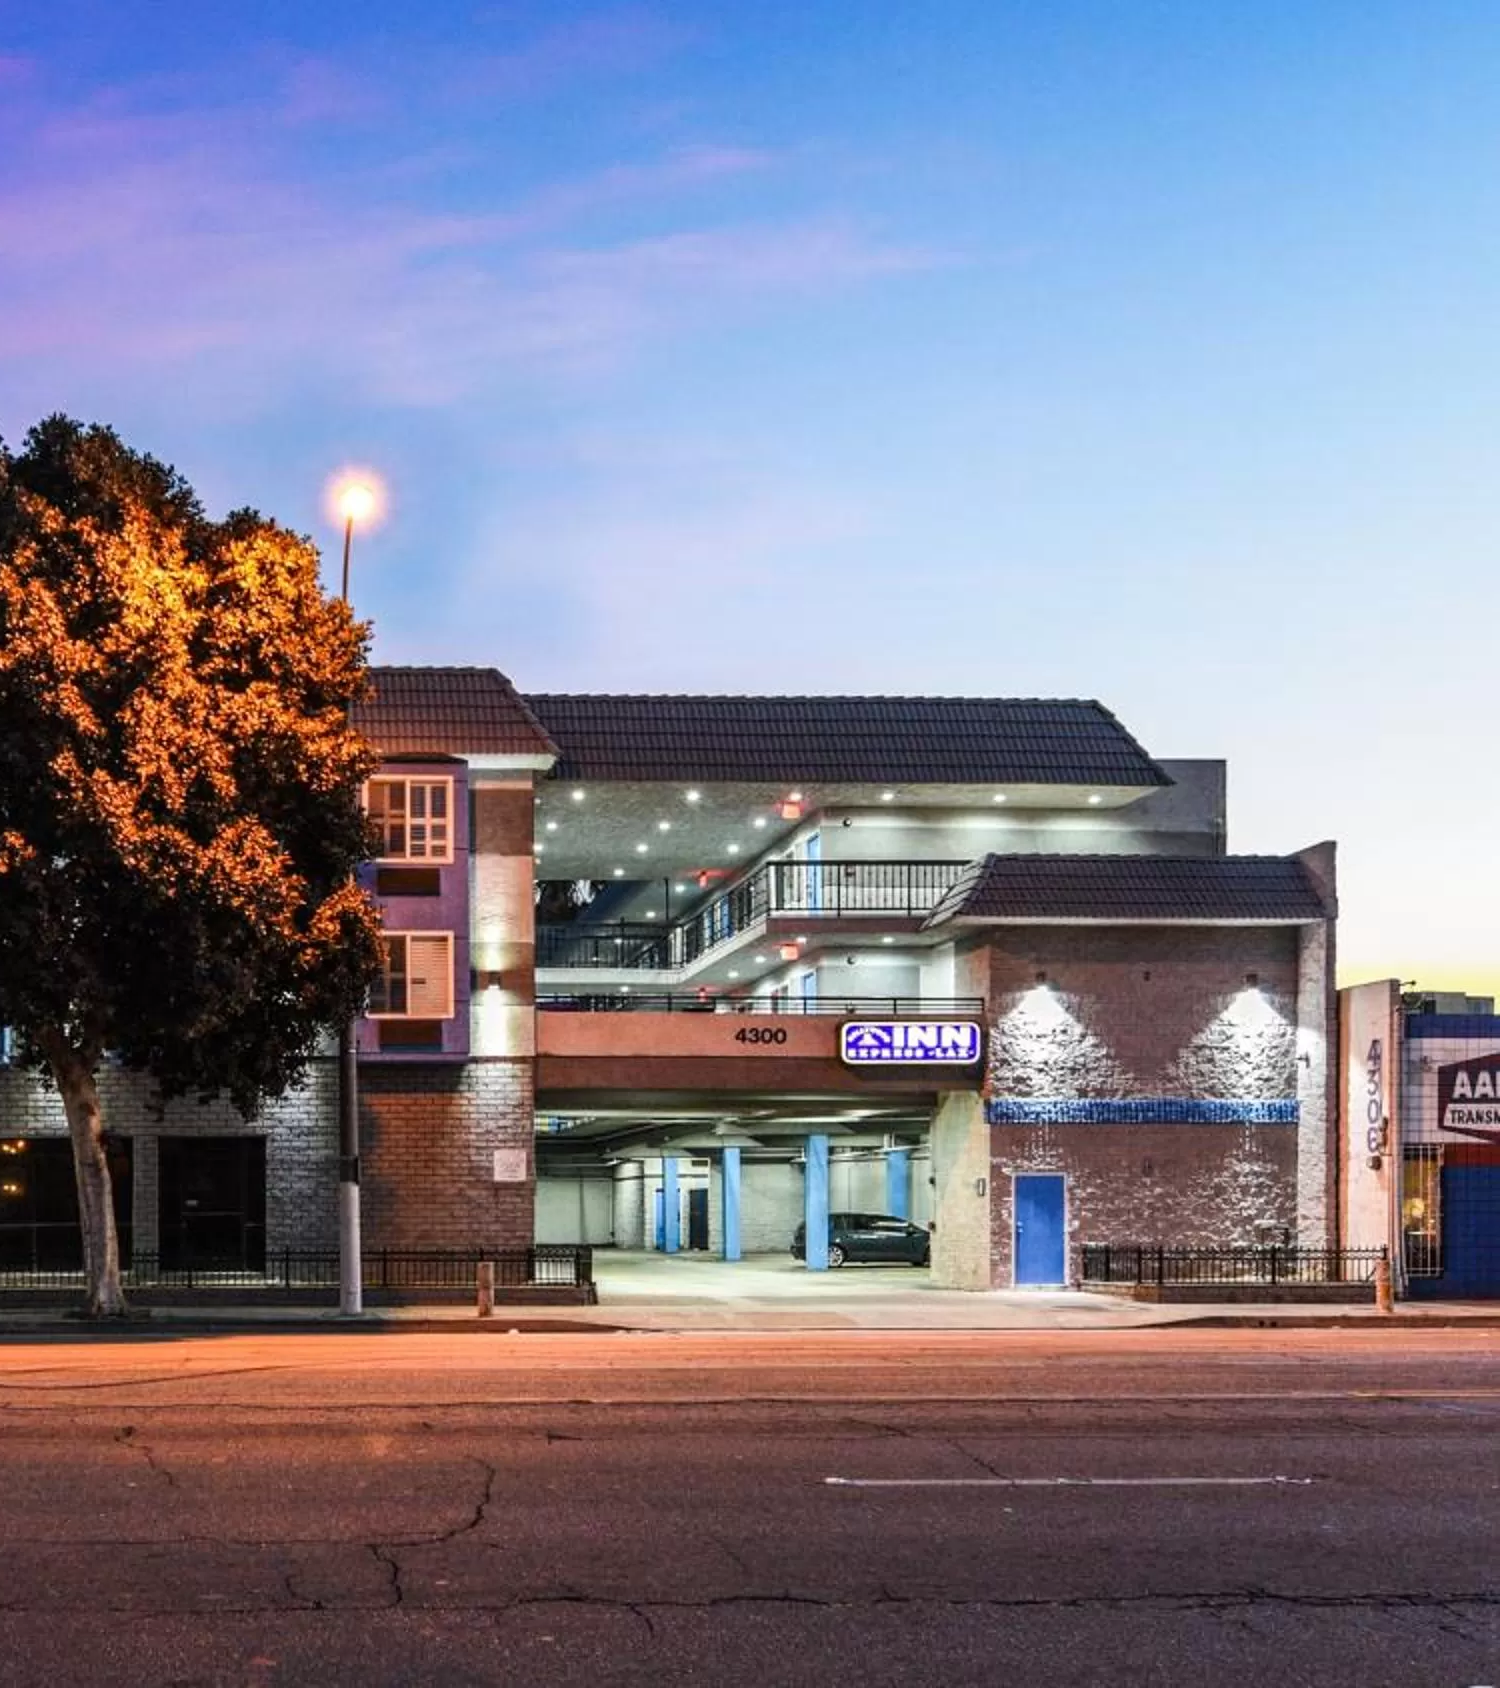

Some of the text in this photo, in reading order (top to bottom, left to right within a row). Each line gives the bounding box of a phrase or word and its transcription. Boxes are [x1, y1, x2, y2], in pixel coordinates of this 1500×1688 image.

[735, 1027, 787, 1045] 4300
[892, 1025, 971, 1047] INN
[1367, 1038, 1382, 1153] 4306
[1452, 1070, 1500, 1099] AA
